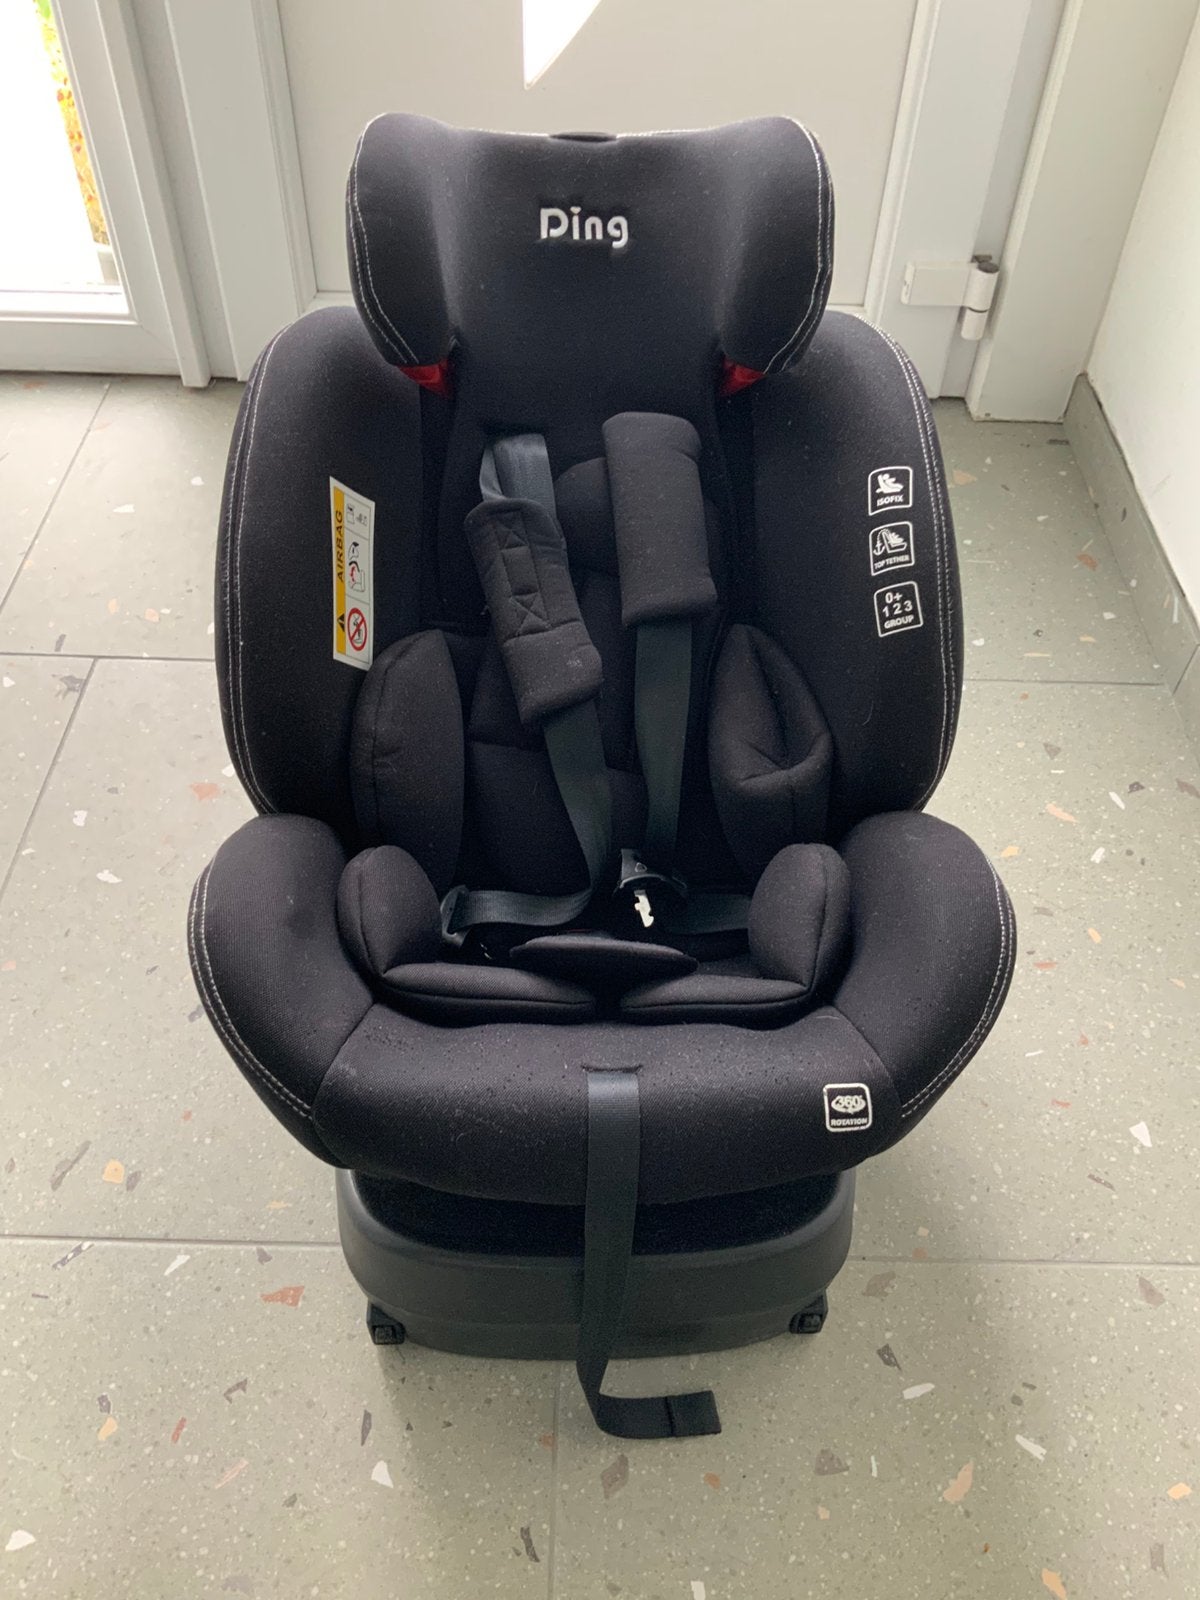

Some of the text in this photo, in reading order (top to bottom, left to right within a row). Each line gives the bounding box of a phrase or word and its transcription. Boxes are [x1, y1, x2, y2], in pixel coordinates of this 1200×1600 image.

[540, 206, 628, 249] Ding
[876, 494, 904, 507] ISOFIX
[335, 510, 345, 582] AIRBAG
[874, 555, 910, 570] TOP TETHER
[885, 592, 903, 604] 0+
[882, 601, 913, 617] 1 2 3
[884, 615, 914, 629] GROUP
[830, 1118, 868, 1126] ROTATION
